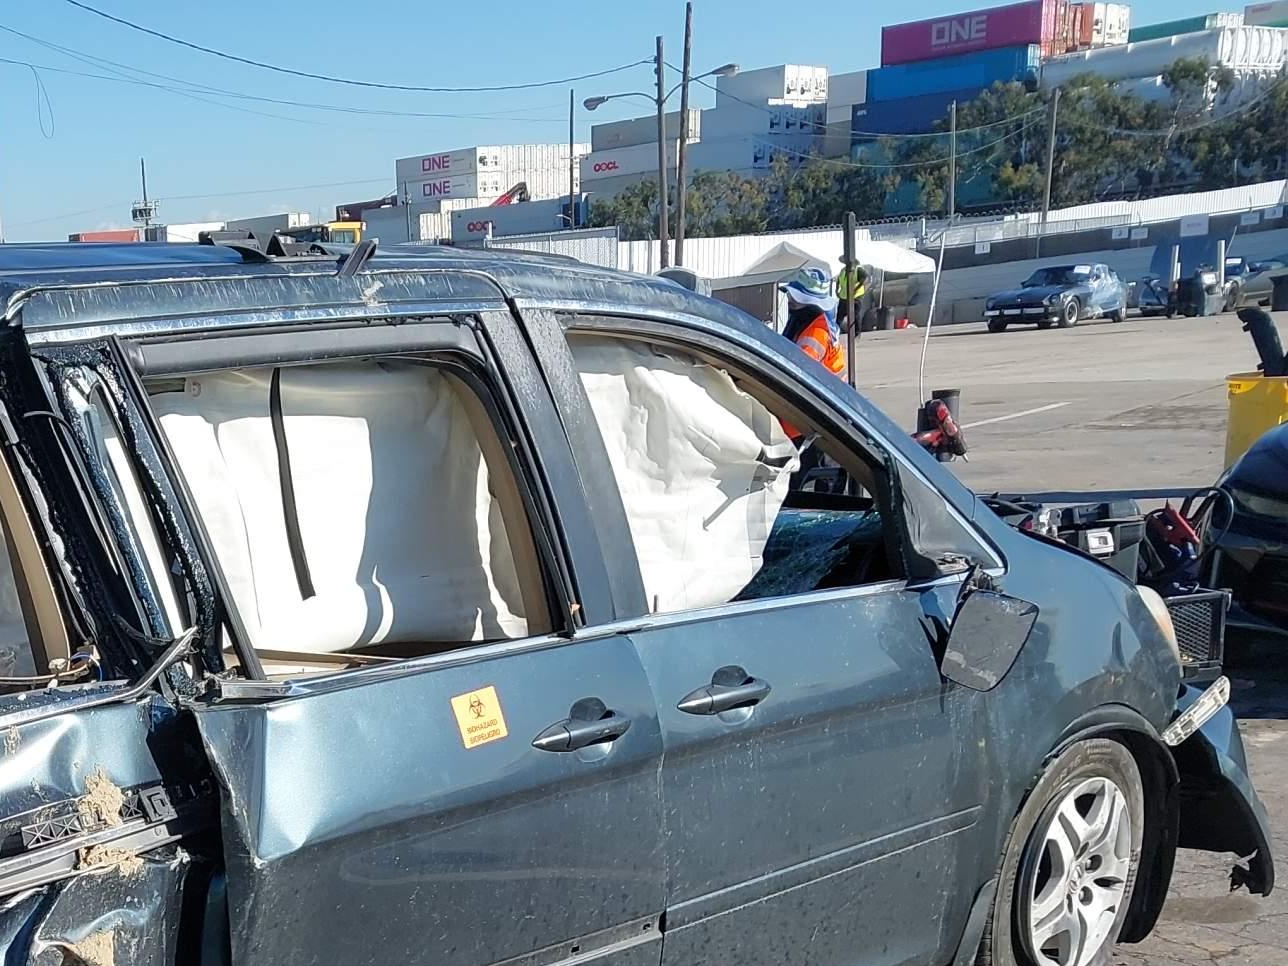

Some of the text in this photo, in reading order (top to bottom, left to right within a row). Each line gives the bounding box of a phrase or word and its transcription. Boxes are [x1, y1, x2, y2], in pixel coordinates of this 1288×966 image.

[931, 15, 987, 45] ONE
[421, 154, 450, 172] ONE
[593, 160, 619, 172] OOCL
[422, 180, 450, 197] ONE
